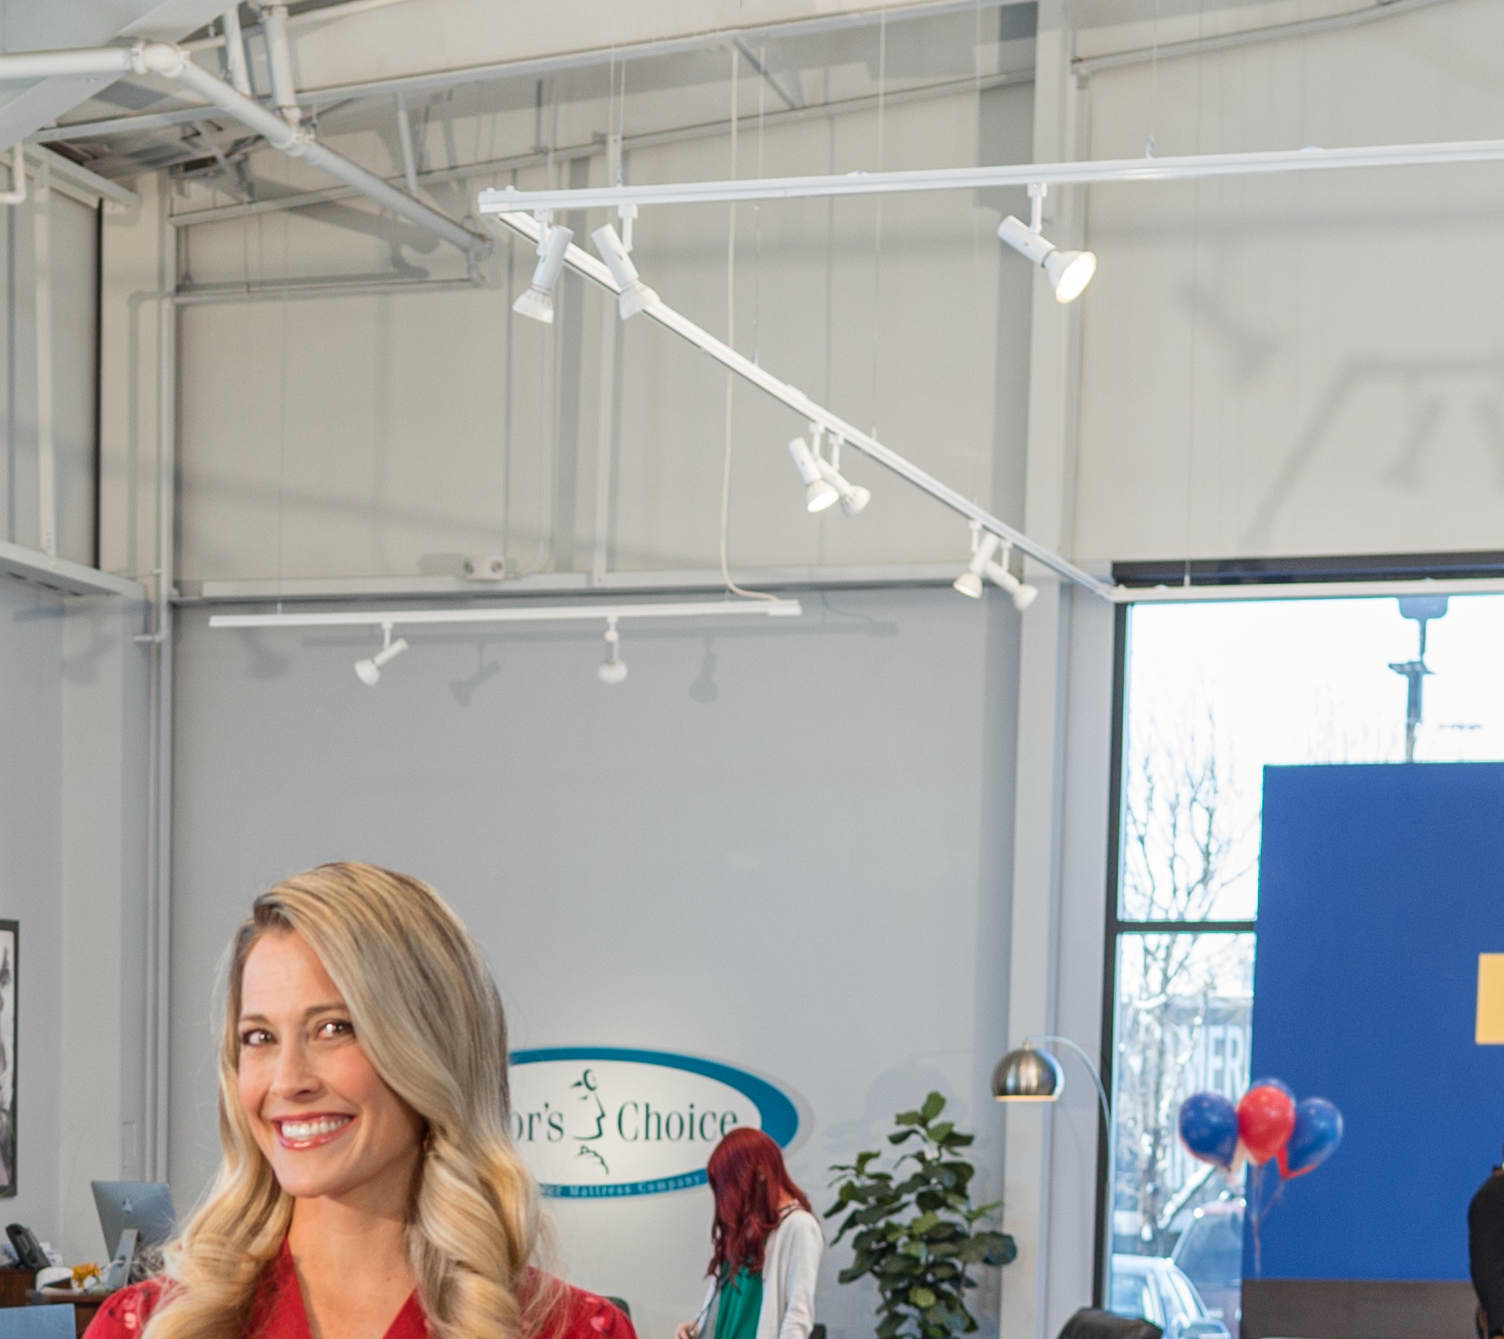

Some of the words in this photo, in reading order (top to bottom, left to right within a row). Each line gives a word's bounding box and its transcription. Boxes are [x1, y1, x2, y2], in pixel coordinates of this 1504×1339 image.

[510, 1102, 565, 1142] or's
[617, 1101, 738, 1142] Choice
[569, 1183, 632, 1198] Mattress
[637, 1174, 701, 1193] Company
